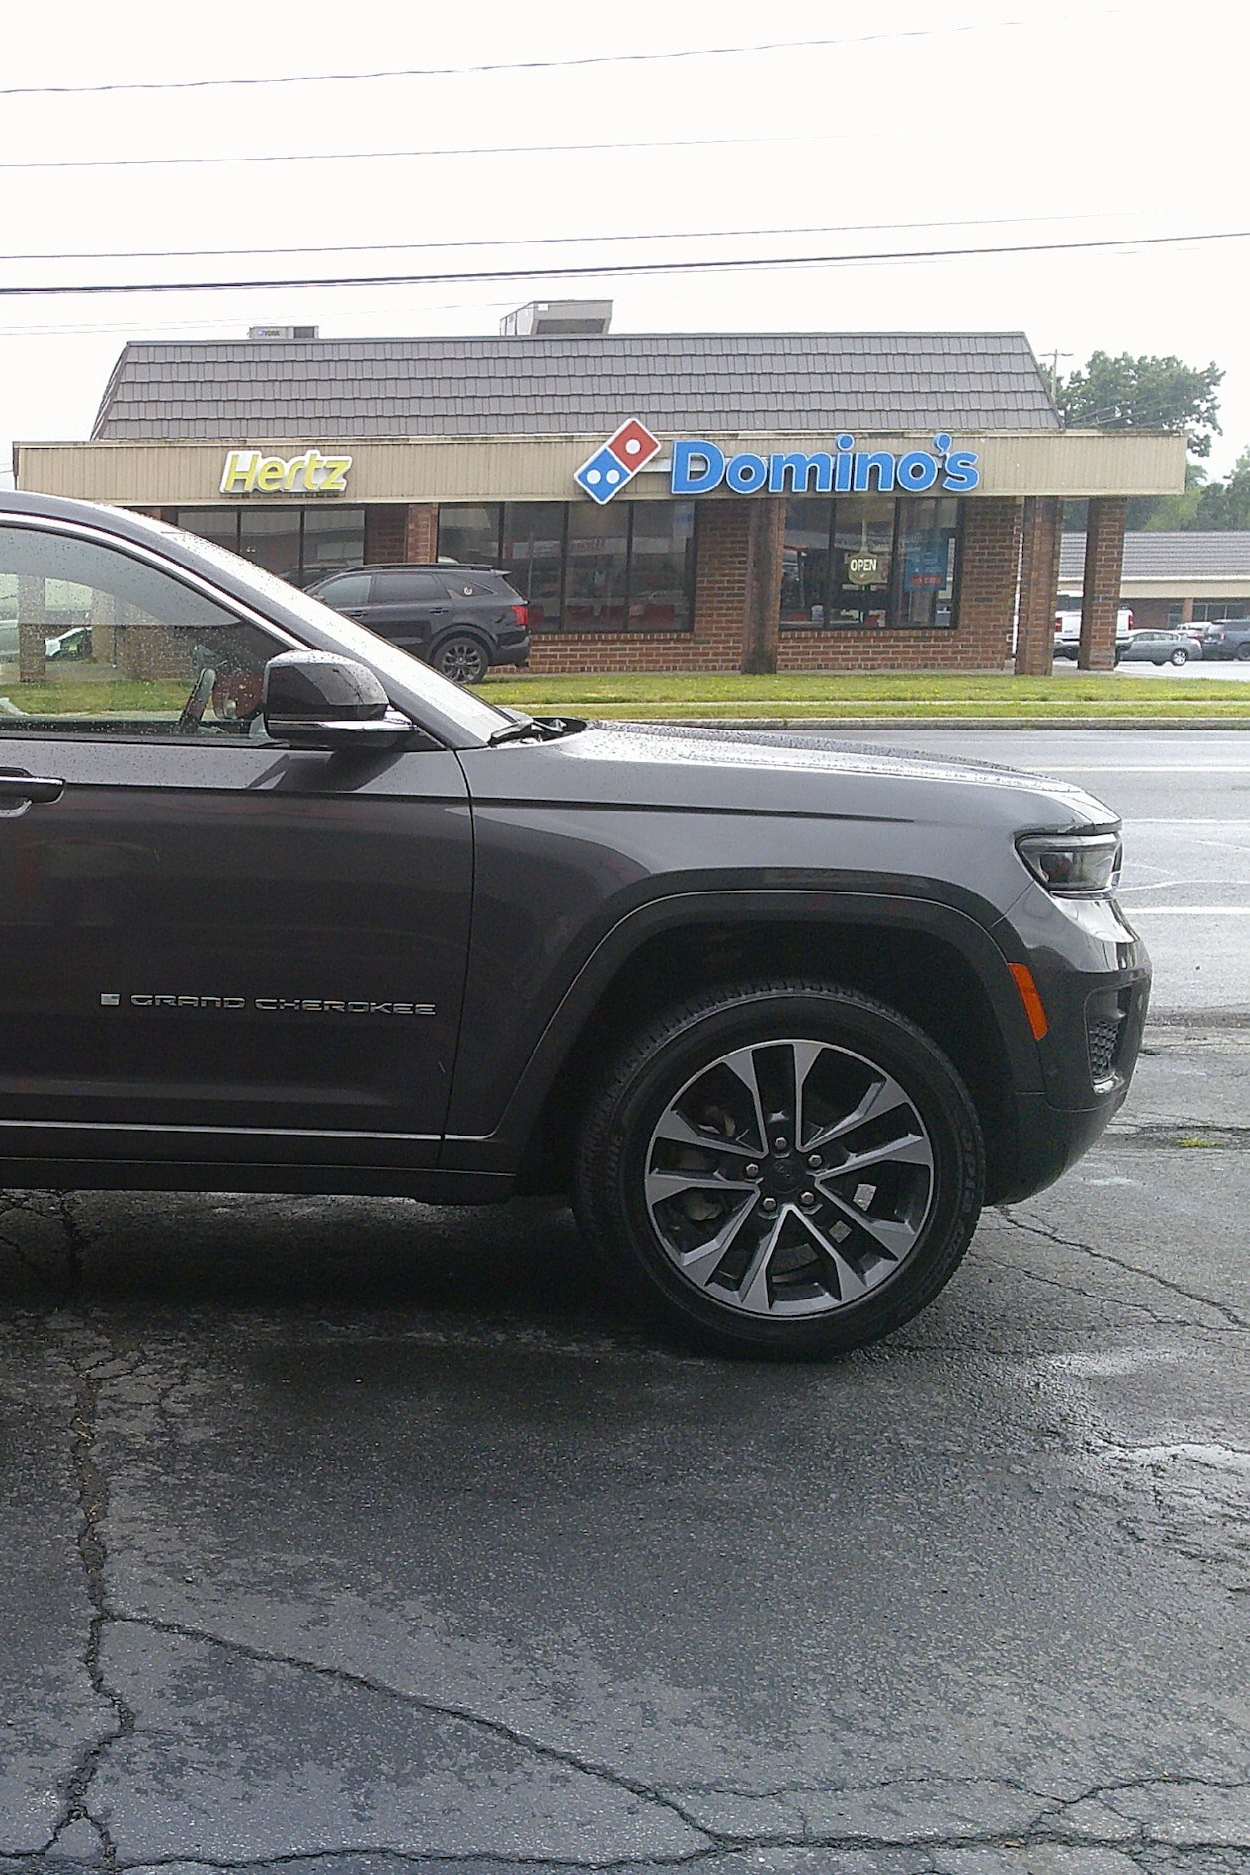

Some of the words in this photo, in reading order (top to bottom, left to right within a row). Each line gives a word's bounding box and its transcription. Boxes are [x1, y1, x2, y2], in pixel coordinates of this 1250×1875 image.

[221, 451, 352, 492] Hertz
[671, 433, 980, 494] Domino's
[850, 559, 877, 571] OPEN
[130, 994, 246, 1009] GRAND
[254, 998, 437, 1016] CHEROKEE
